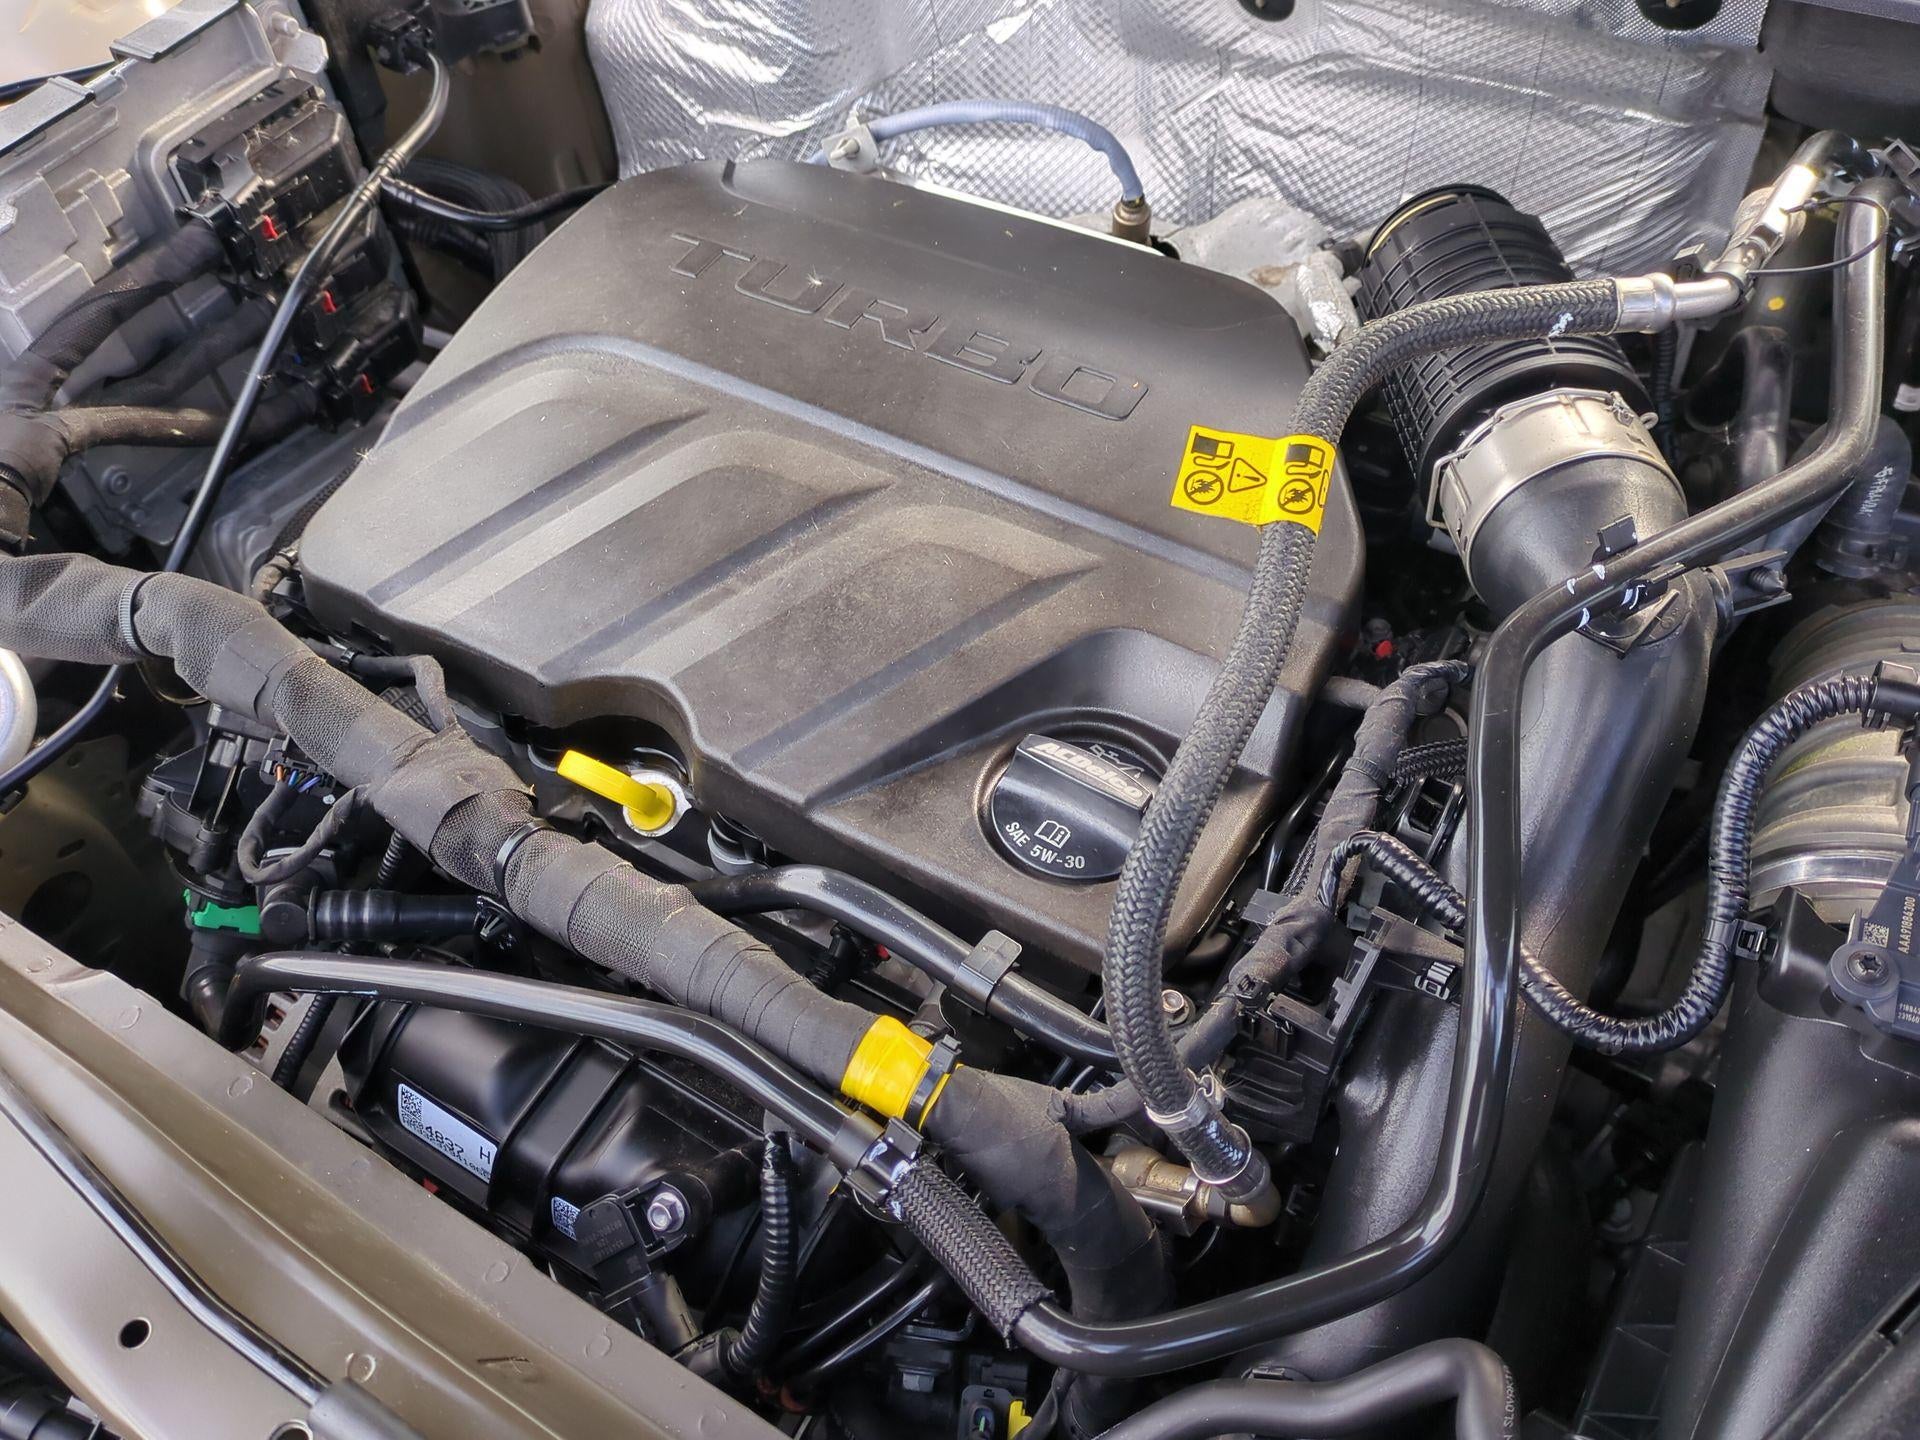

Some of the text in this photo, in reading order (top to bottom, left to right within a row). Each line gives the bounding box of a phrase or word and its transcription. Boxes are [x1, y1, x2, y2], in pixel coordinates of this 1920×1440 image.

[669, 232, 1149, 422] TURBO
[1027, 742, 1143, 799] ACDelco
[1005, 821, 1086, 869] SAE 5W-30
[480, 1146, 491, 1165] H
